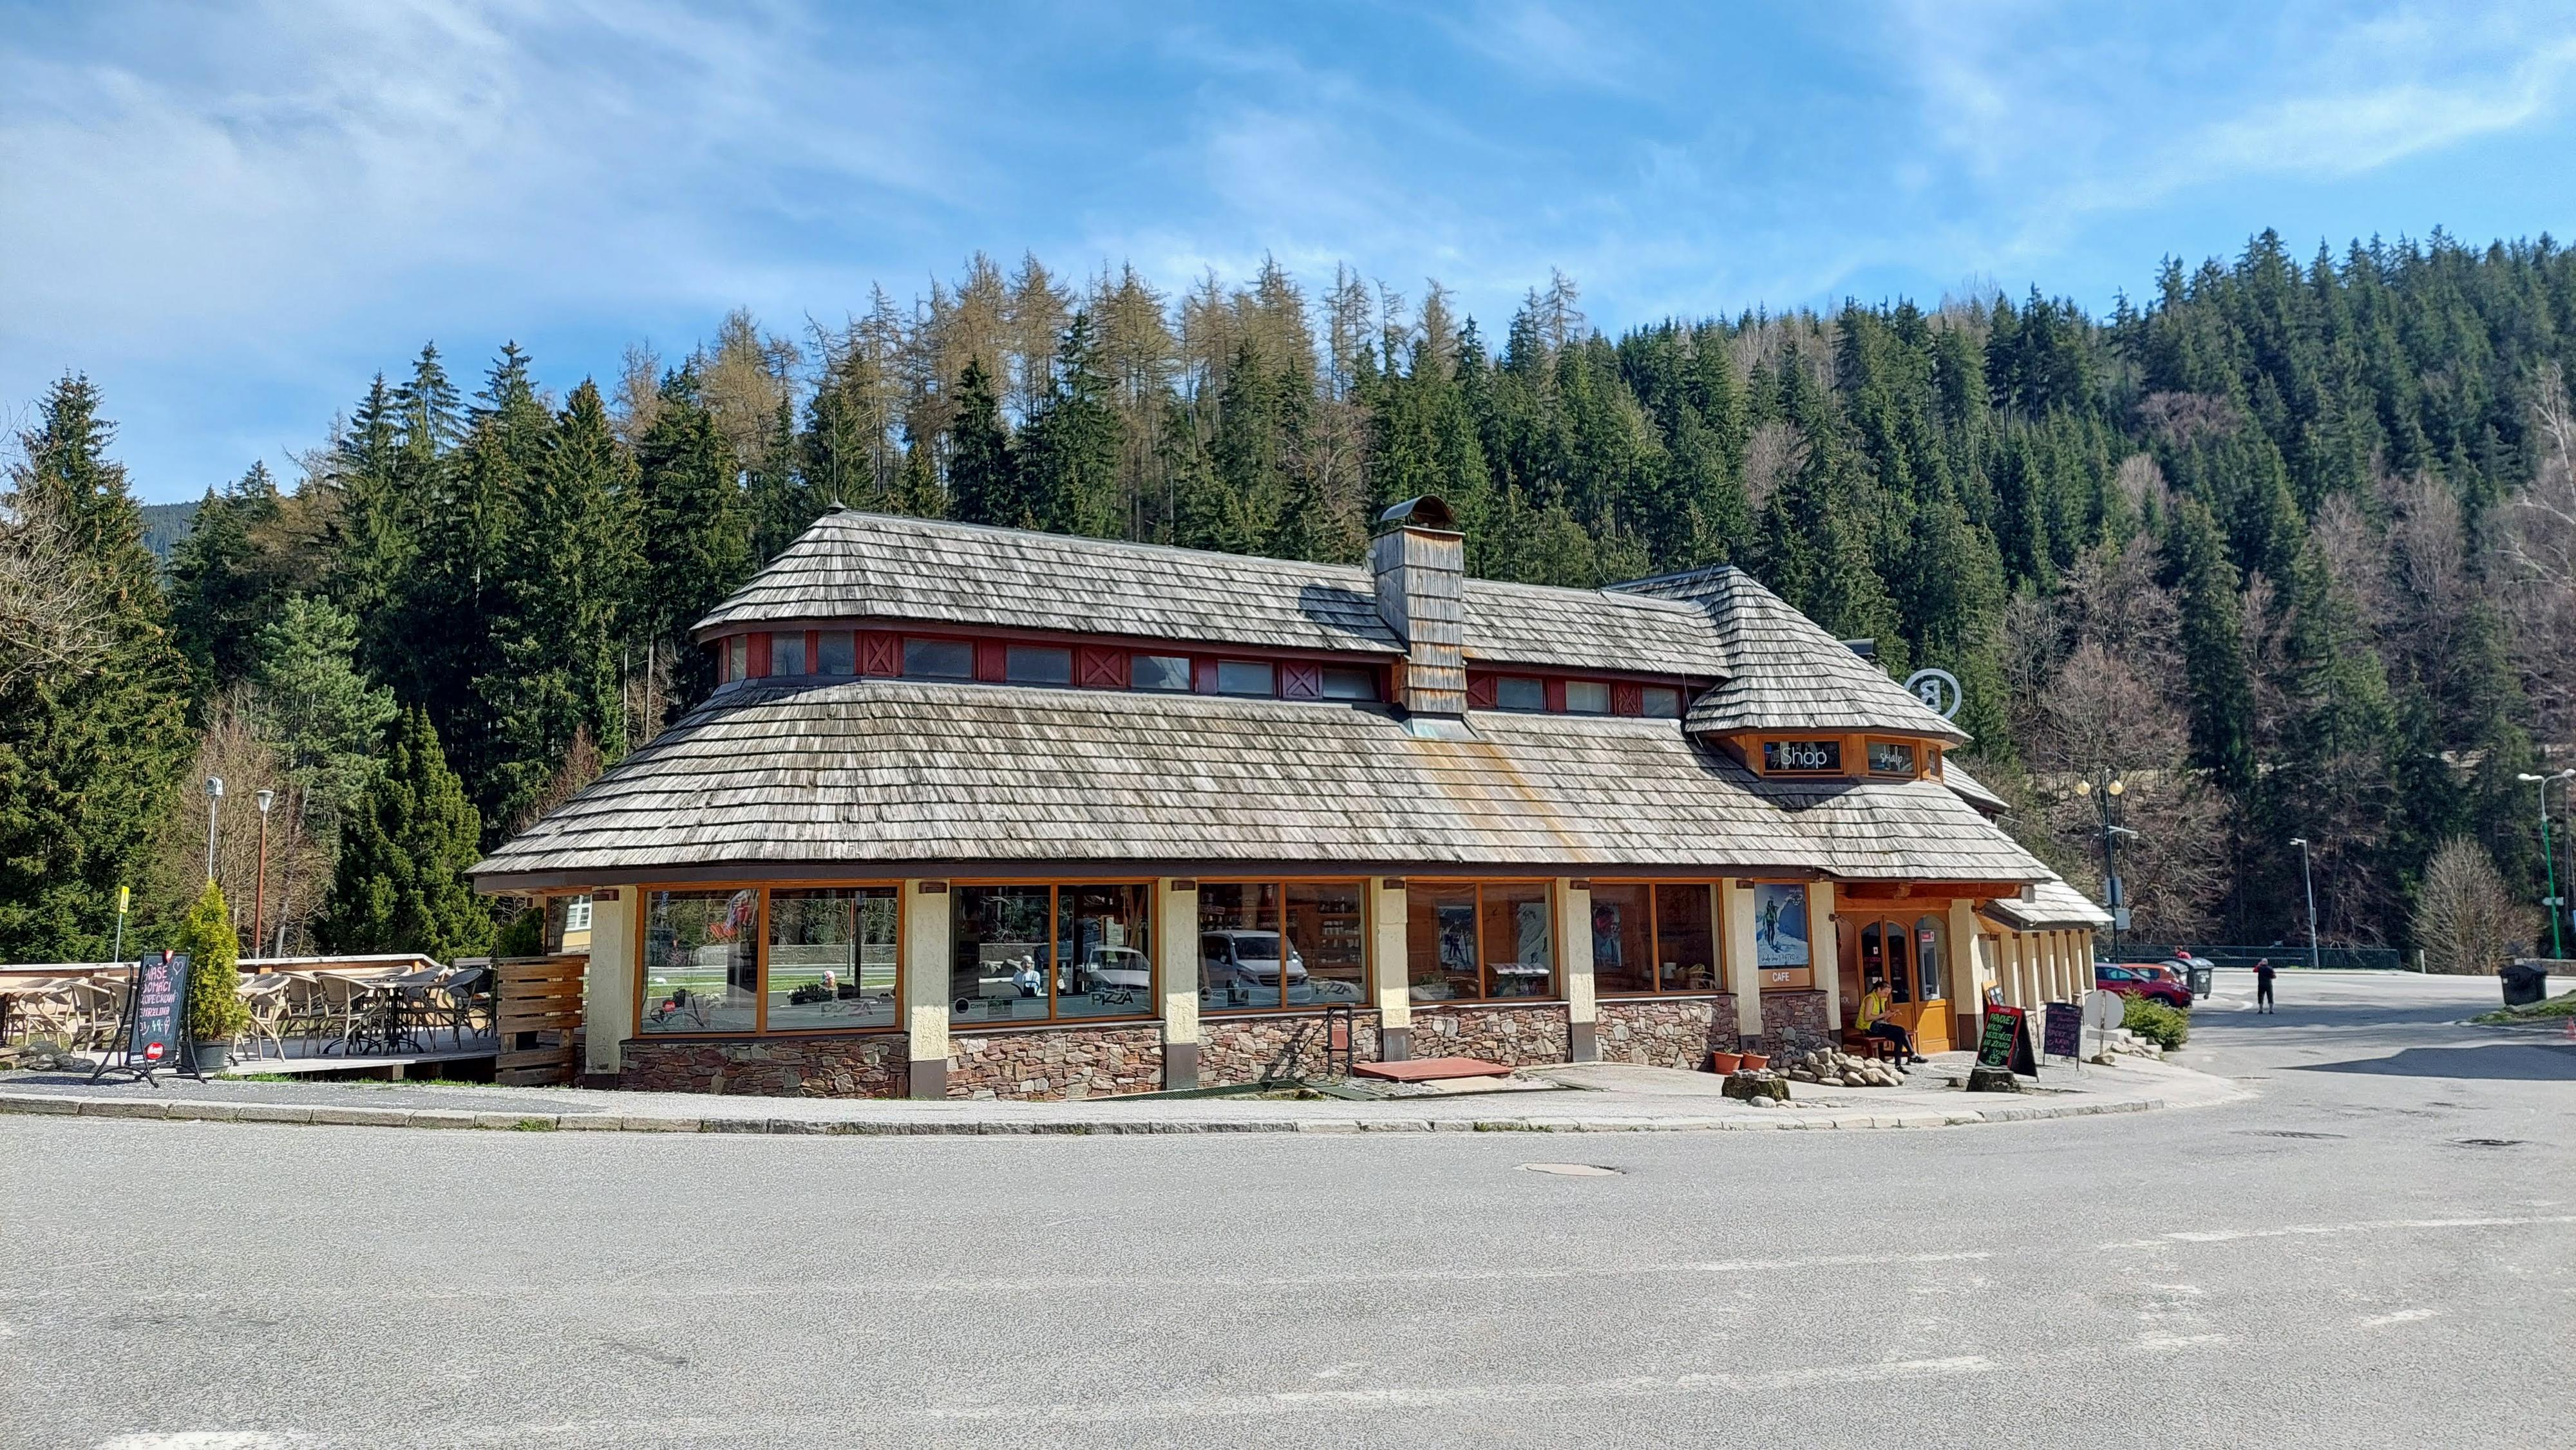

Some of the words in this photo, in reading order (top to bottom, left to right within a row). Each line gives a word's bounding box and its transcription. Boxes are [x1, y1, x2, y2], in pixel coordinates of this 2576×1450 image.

[1781, 746, 1828, 769] Shop
[1880, 745, 1903, 772] skialp
[144, 962, 168, 981] NAŠE
[1772, 972, 1790, 982] CAFE
[1315, 979, 1352, 995] PIZZA
[1091, 989, 1134, 1006] PIZZA
